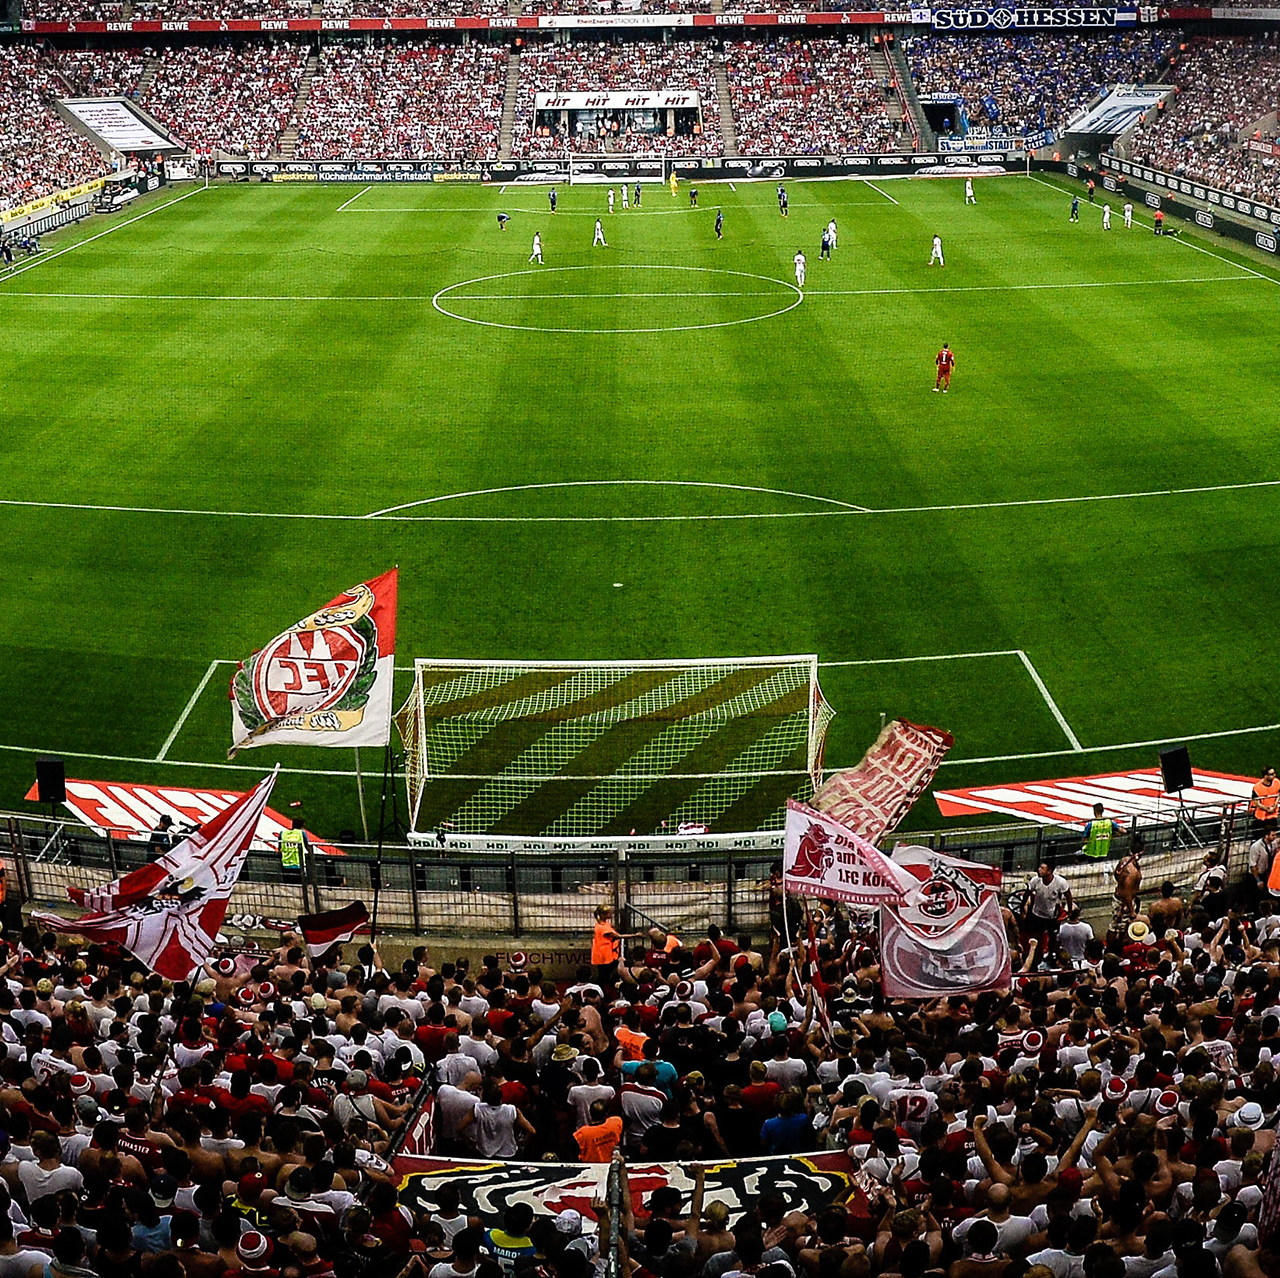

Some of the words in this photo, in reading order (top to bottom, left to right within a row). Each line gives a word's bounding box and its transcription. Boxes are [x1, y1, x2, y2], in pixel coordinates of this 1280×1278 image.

[489, 18, 518, 27] REWE
[716, 15, 745, 24] REWE
[777, 15, 807, 24] REWE
[884, 14, 912, 23] REWE
[935, 8, 989, 28] SÜD
[1014, 8, 1117, 27] HESSEN
[106, 22, 132, 31] REWE
[162, 21, 189, 30] REWE
[261, 21, 288, 30] REWE
[322, 20, 349, 29] REWE
[427, 19, 456, 28] REWE
[414, 840, 435, 848] HDI
[449, 841, 471, 849] HDI
[837, 851, 856, 864] am
[839, 868, 859, 885] 1.FC
